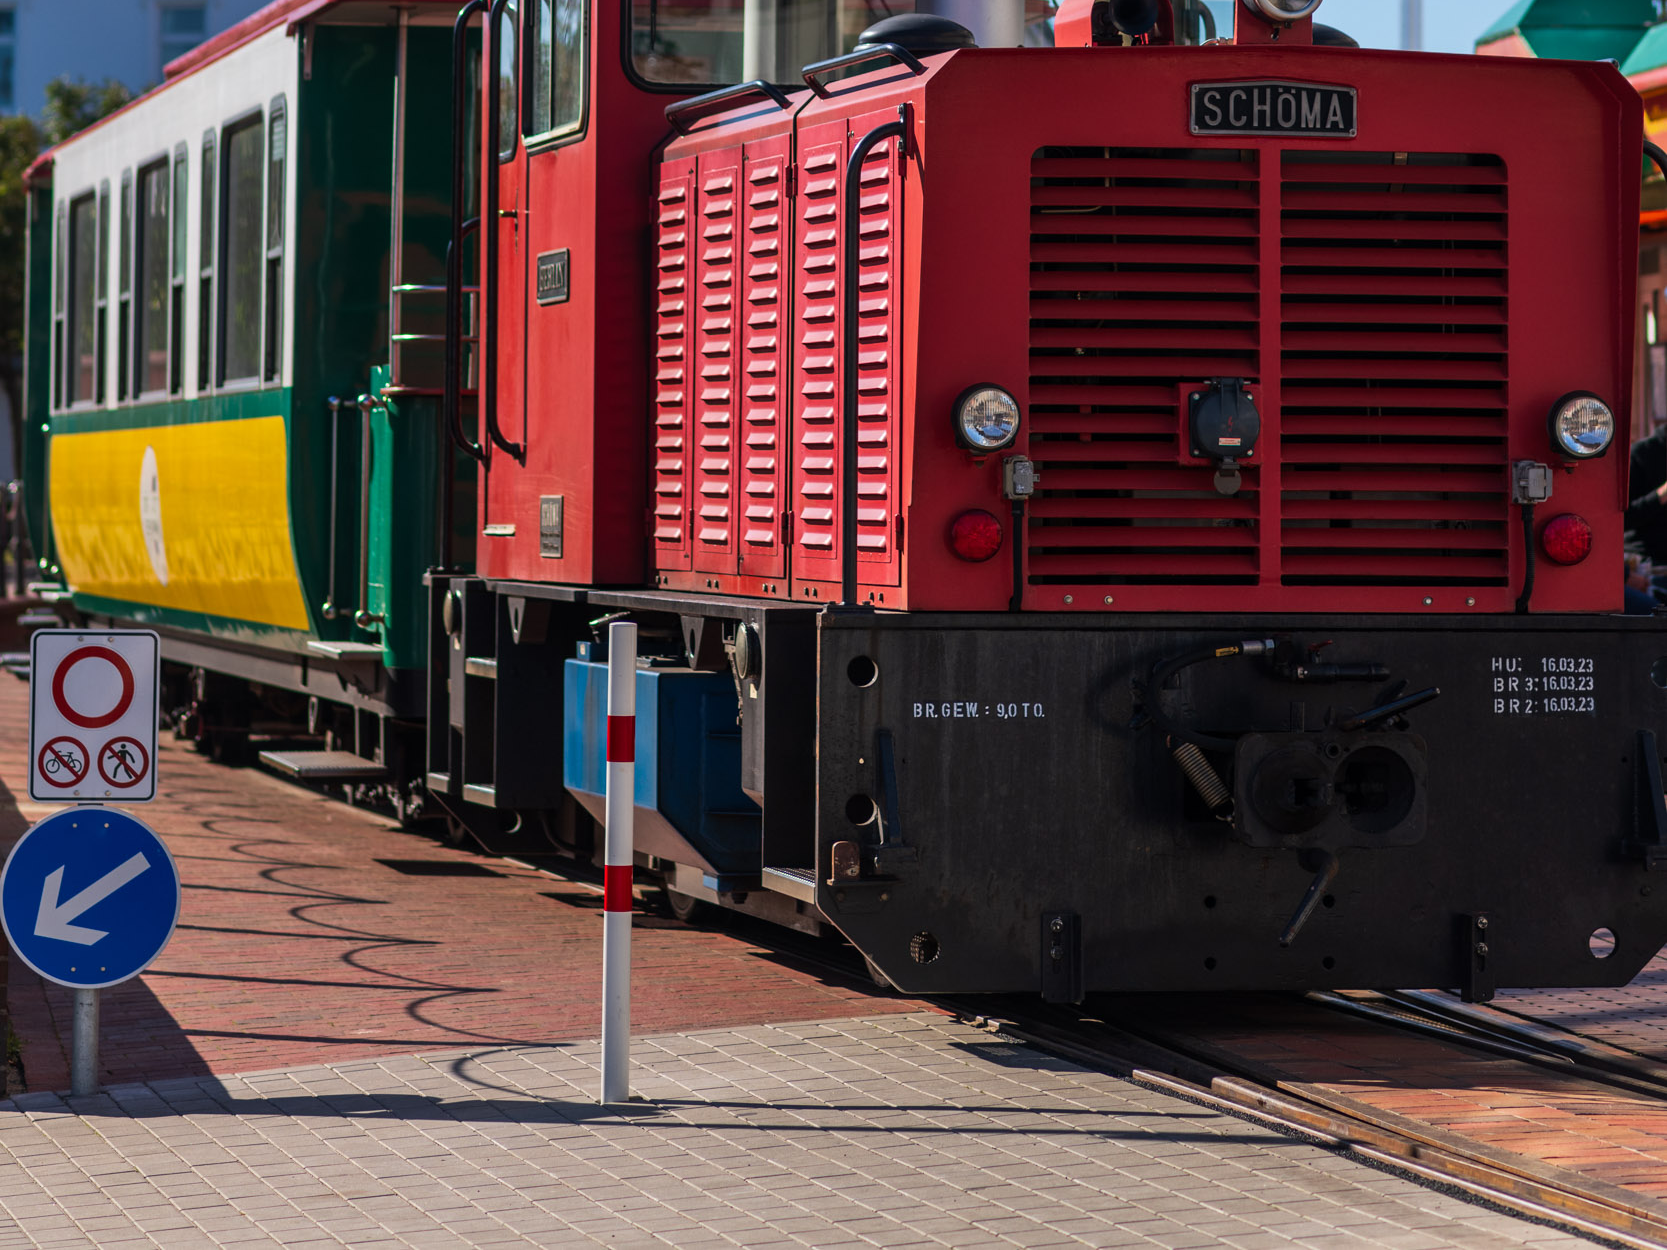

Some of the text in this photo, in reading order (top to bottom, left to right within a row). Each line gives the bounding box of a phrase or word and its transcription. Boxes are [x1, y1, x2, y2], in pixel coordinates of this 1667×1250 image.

[1203, 88, 1345, 129] SCHÖMA
[1541, 657, 1594, 673] 16.03.23
[1542, 675, 1595, 692] 16.03.23
[1543, 696, 1595, 713] 16.03.23
